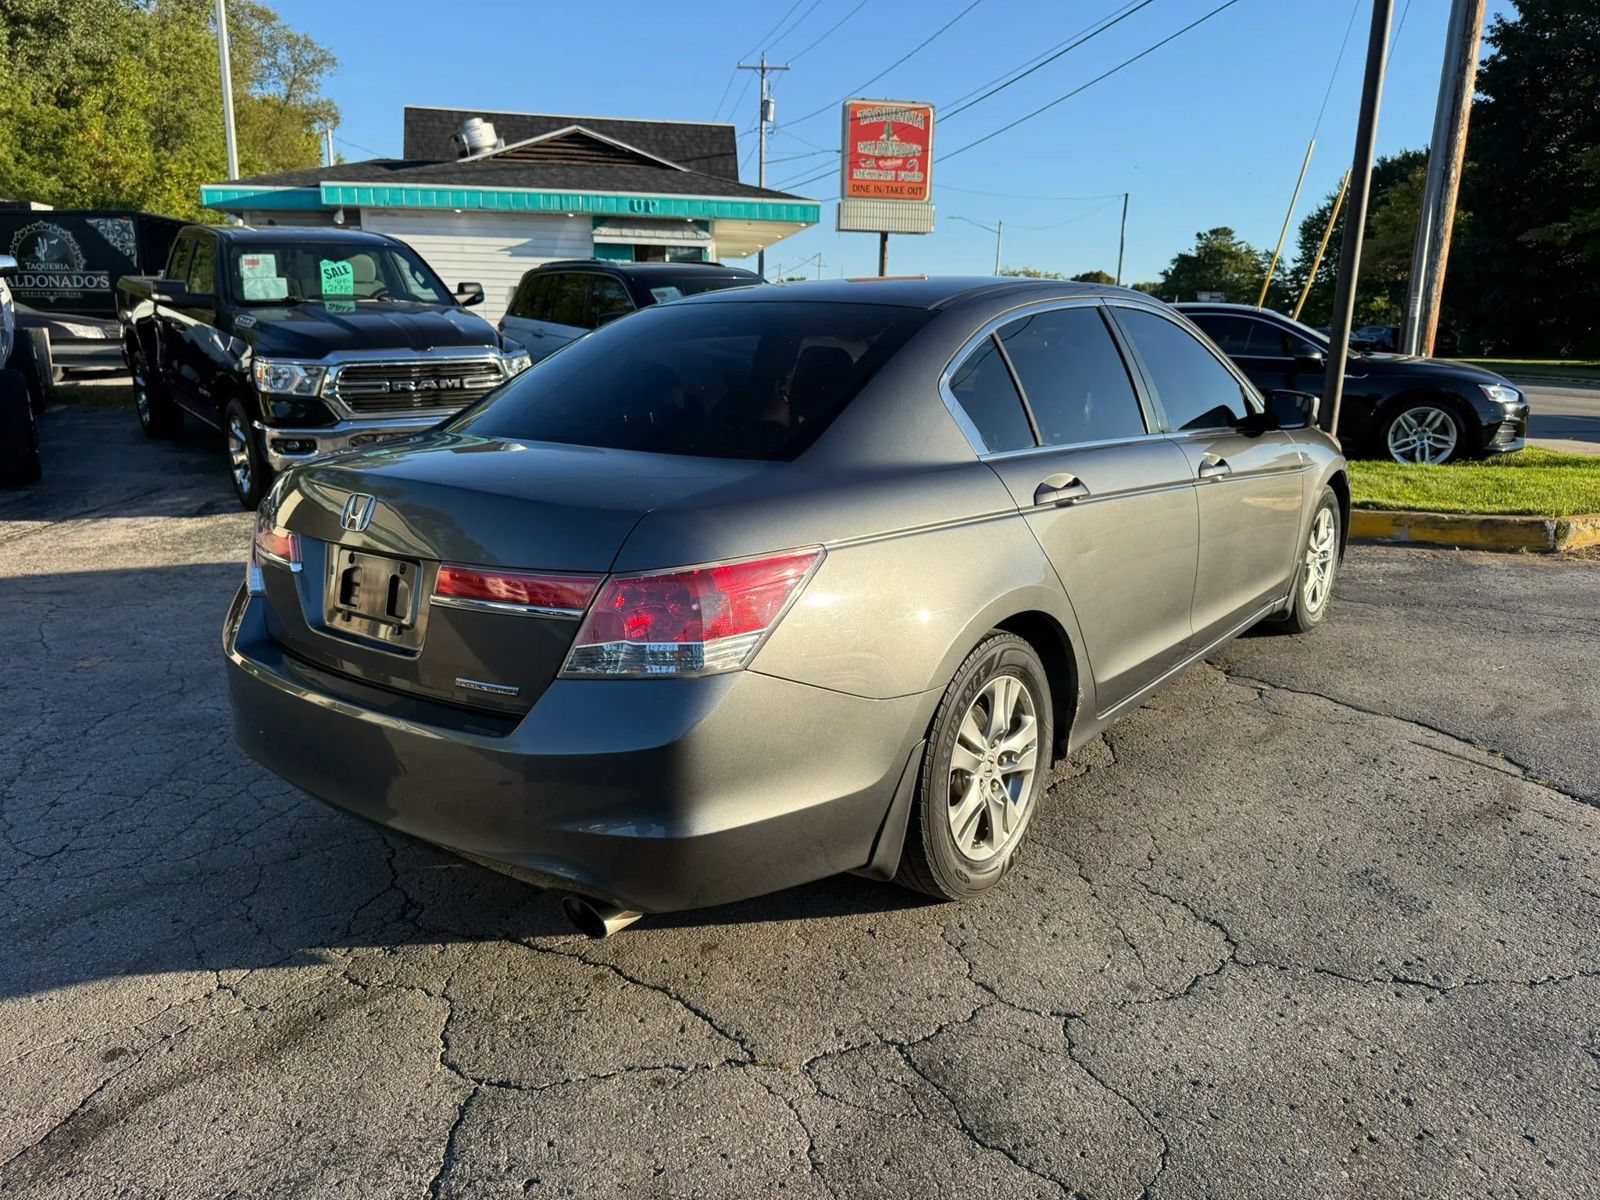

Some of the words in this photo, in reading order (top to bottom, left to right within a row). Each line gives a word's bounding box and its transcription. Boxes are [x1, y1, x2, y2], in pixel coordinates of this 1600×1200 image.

[852, 184, 871, 193] DINE
[886, 184, 904, 195] TAKE
[907, 185, 923, 195] OUT
[25, 262, 70, 271] TAQUERIA
[323, 265, 351, 280] SALE
[4, 274, 110, 288] ALDONADO'S
[392, 379, 460, 392] RAM
